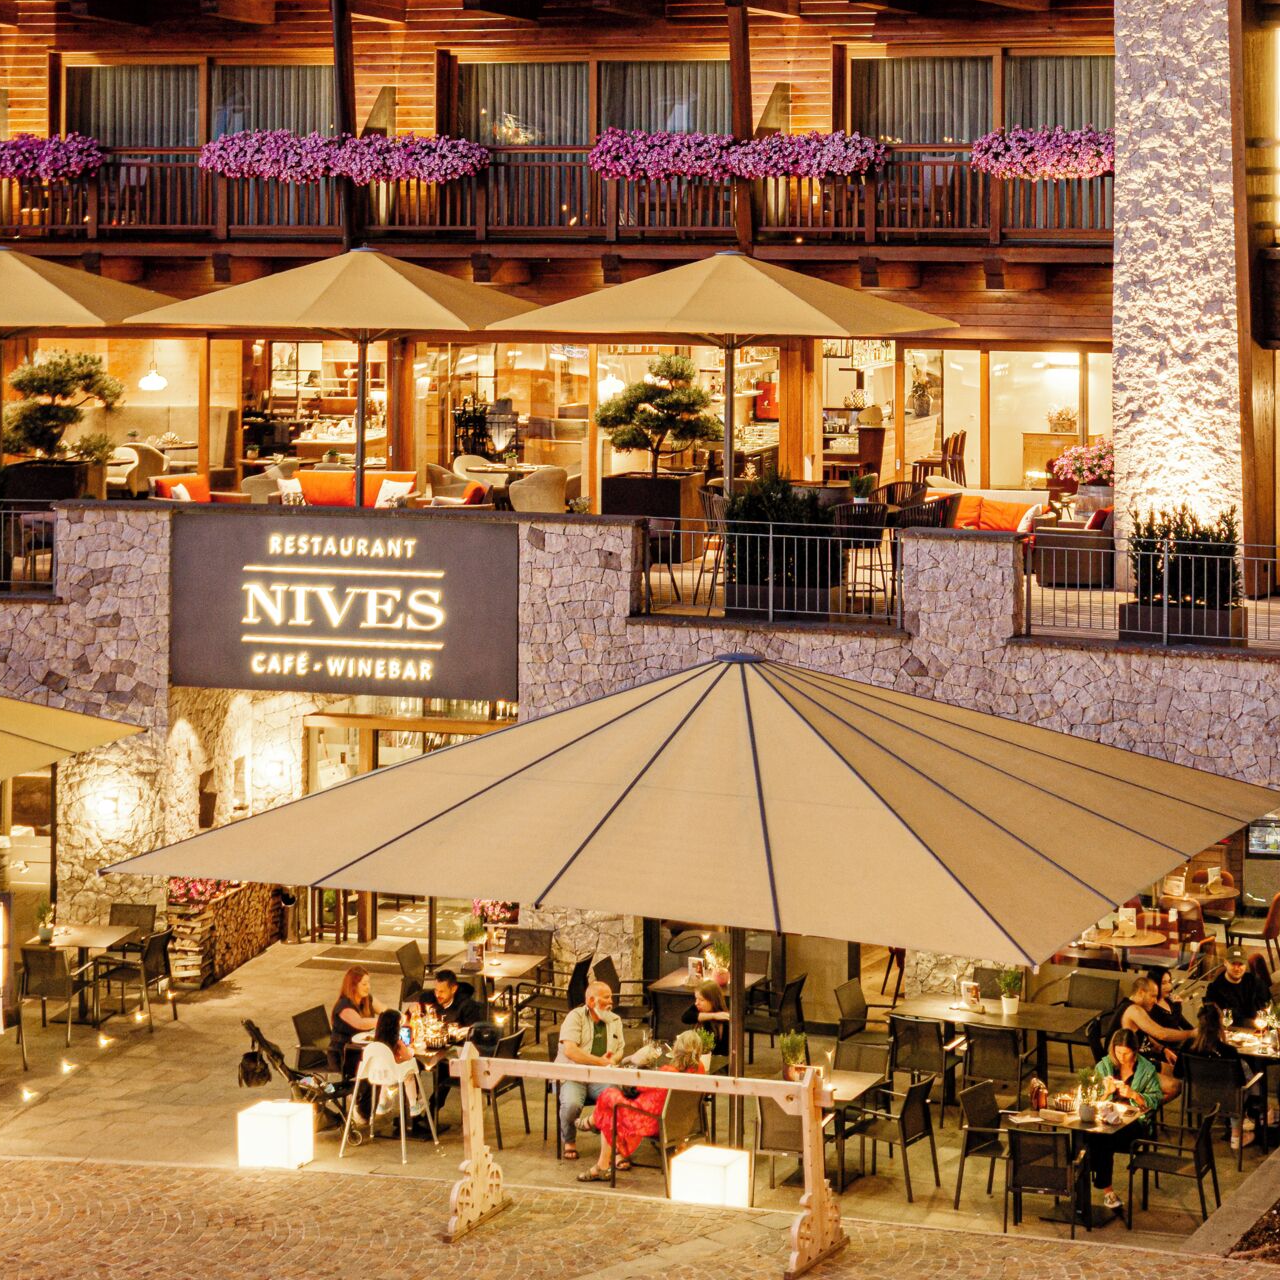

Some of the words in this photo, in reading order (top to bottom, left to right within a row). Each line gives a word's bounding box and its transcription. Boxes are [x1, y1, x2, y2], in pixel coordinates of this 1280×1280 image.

[269, 534, 417, 558] RESTAURANT
[241, 582, 445, 631] NIVES
[251, 651, 309, 675] CAFÉ
[326, 657, 433, 682] WINEBAR
